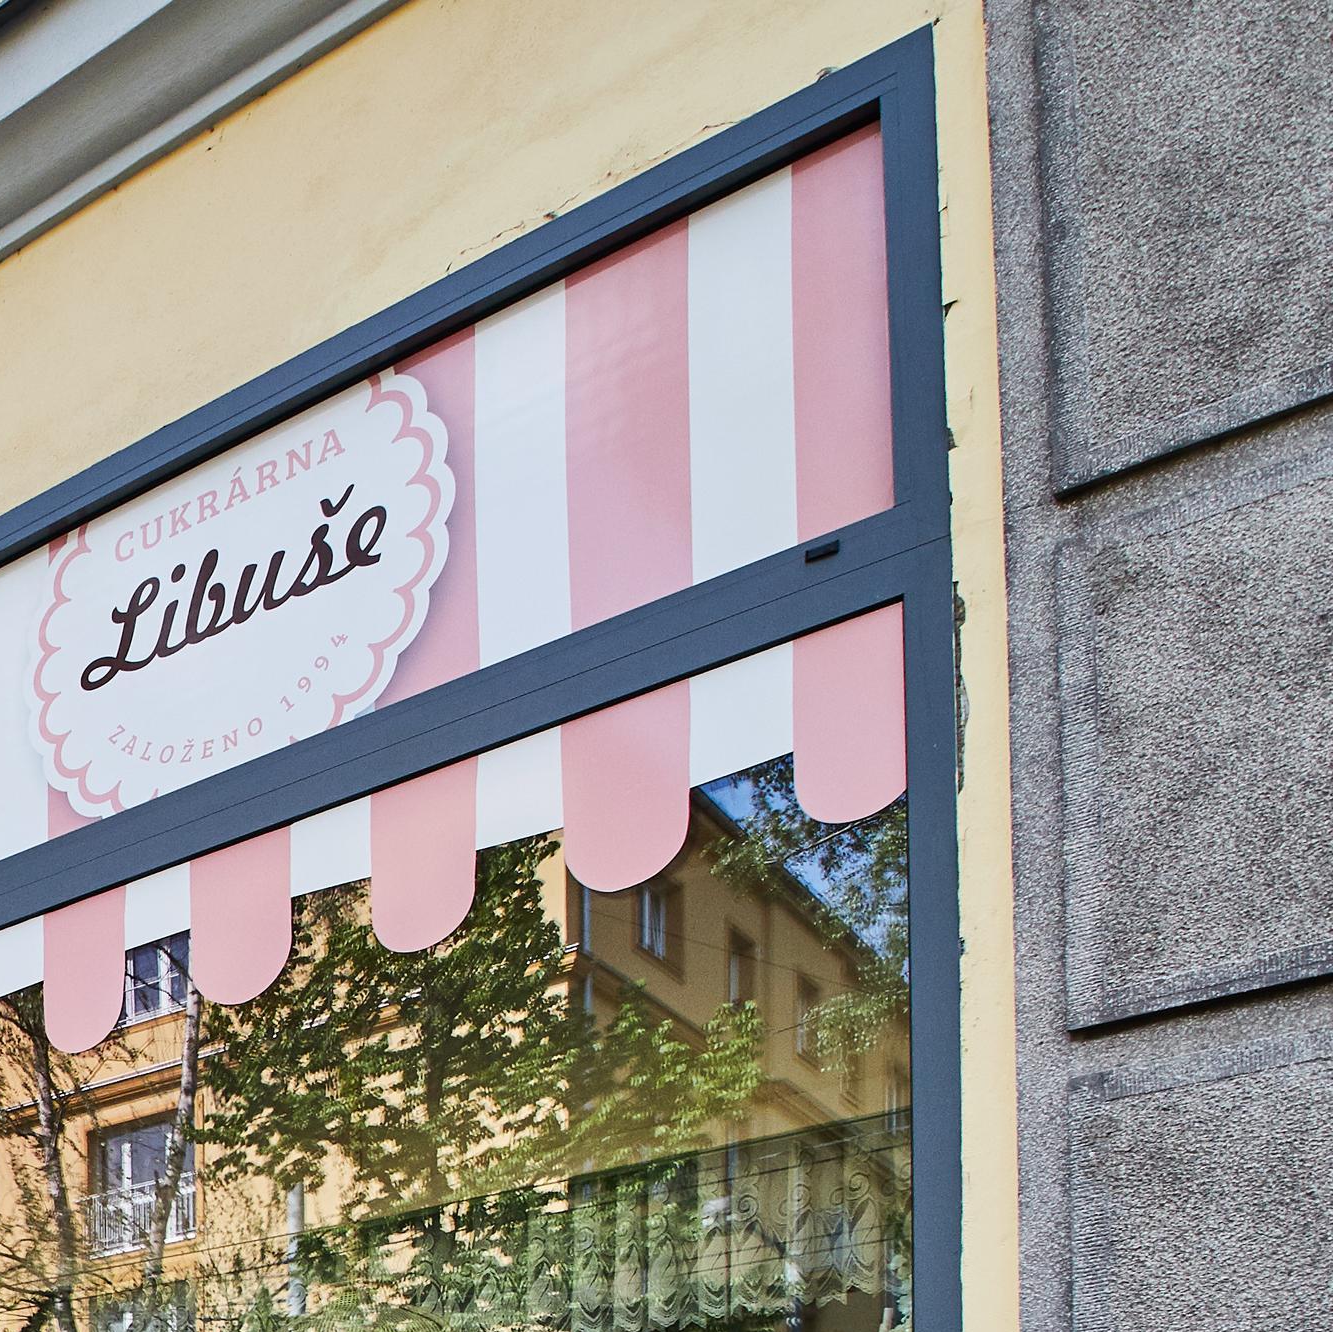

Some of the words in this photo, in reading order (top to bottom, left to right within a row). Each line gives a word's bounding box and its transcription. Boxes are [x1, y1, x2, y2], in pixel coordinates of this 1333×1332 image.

[114, 427, 346, 564] CUKRÁRNA
[80, 484, 388, 692] Libuše
[107, 717, 264, 765] ZALOŽENO
[278, 632, 349, 713] 1994
